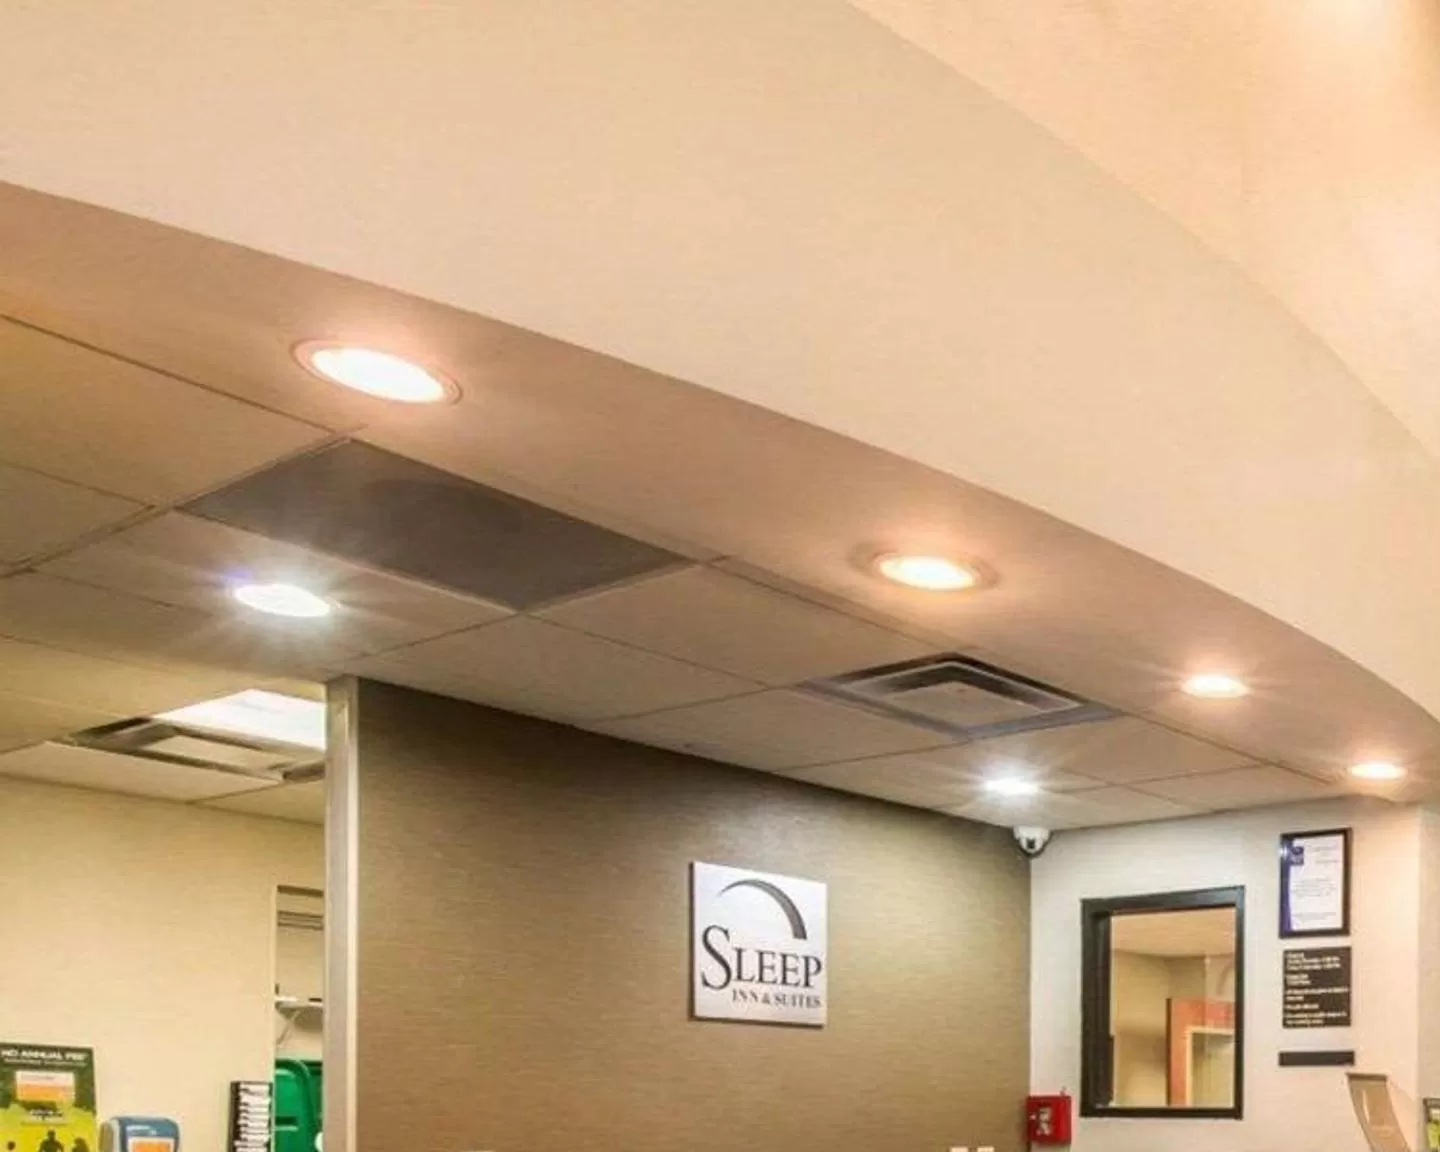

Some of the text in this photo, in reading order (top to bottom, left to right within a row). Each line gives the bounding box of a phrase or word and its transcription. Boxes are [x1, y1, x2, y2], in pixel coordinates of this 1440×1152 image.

[701, 925, 821, 990] SLEEP
[732, 989, 759, 1003] INN
[774, 994, 821, 1009] SUITES
